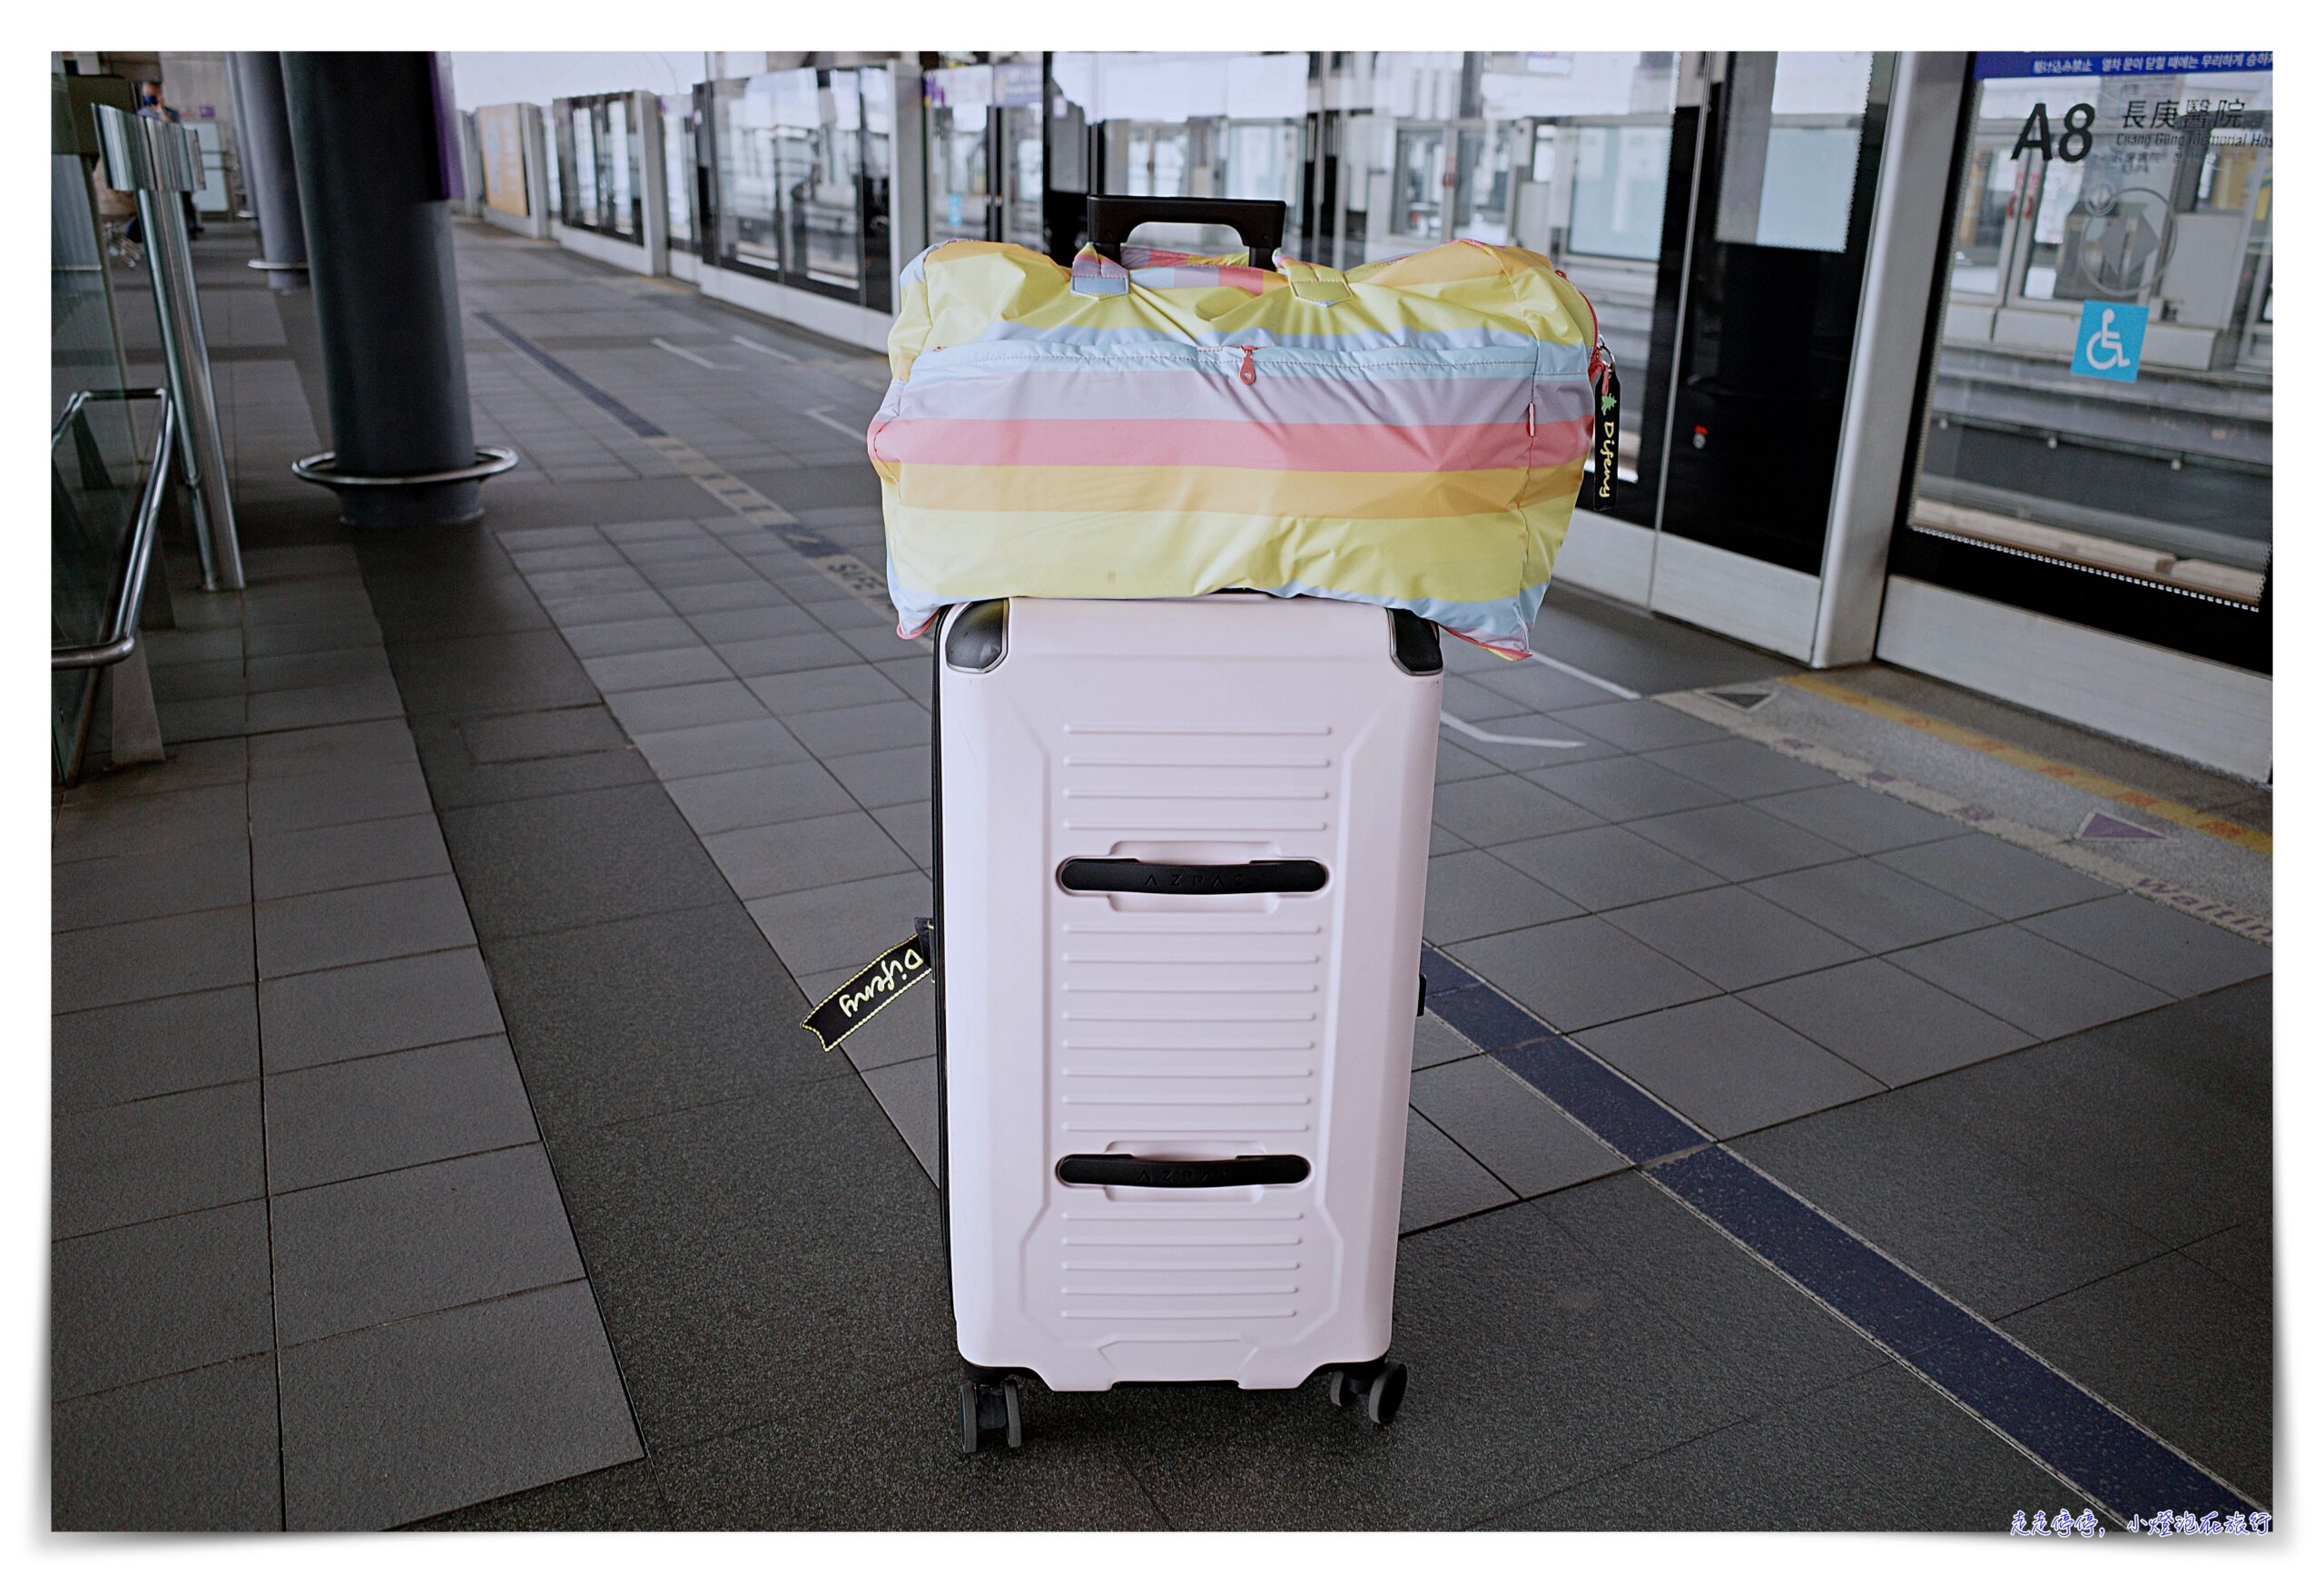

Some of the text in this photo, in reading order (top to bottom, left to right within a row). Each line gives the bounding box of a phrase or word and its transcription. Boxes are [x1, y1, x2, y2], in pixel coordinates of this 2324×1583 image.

[2201, 53, 2243, 68] 무리하게
[2247, 52, 2273, 66] 승하
[2122, 98, 2246, 129] 長庚醫院
[2010, 102, 2096, 162] A8
[2116, 133, 2152, 148] Chang
[2154, 133, 2184, 148] Gung
